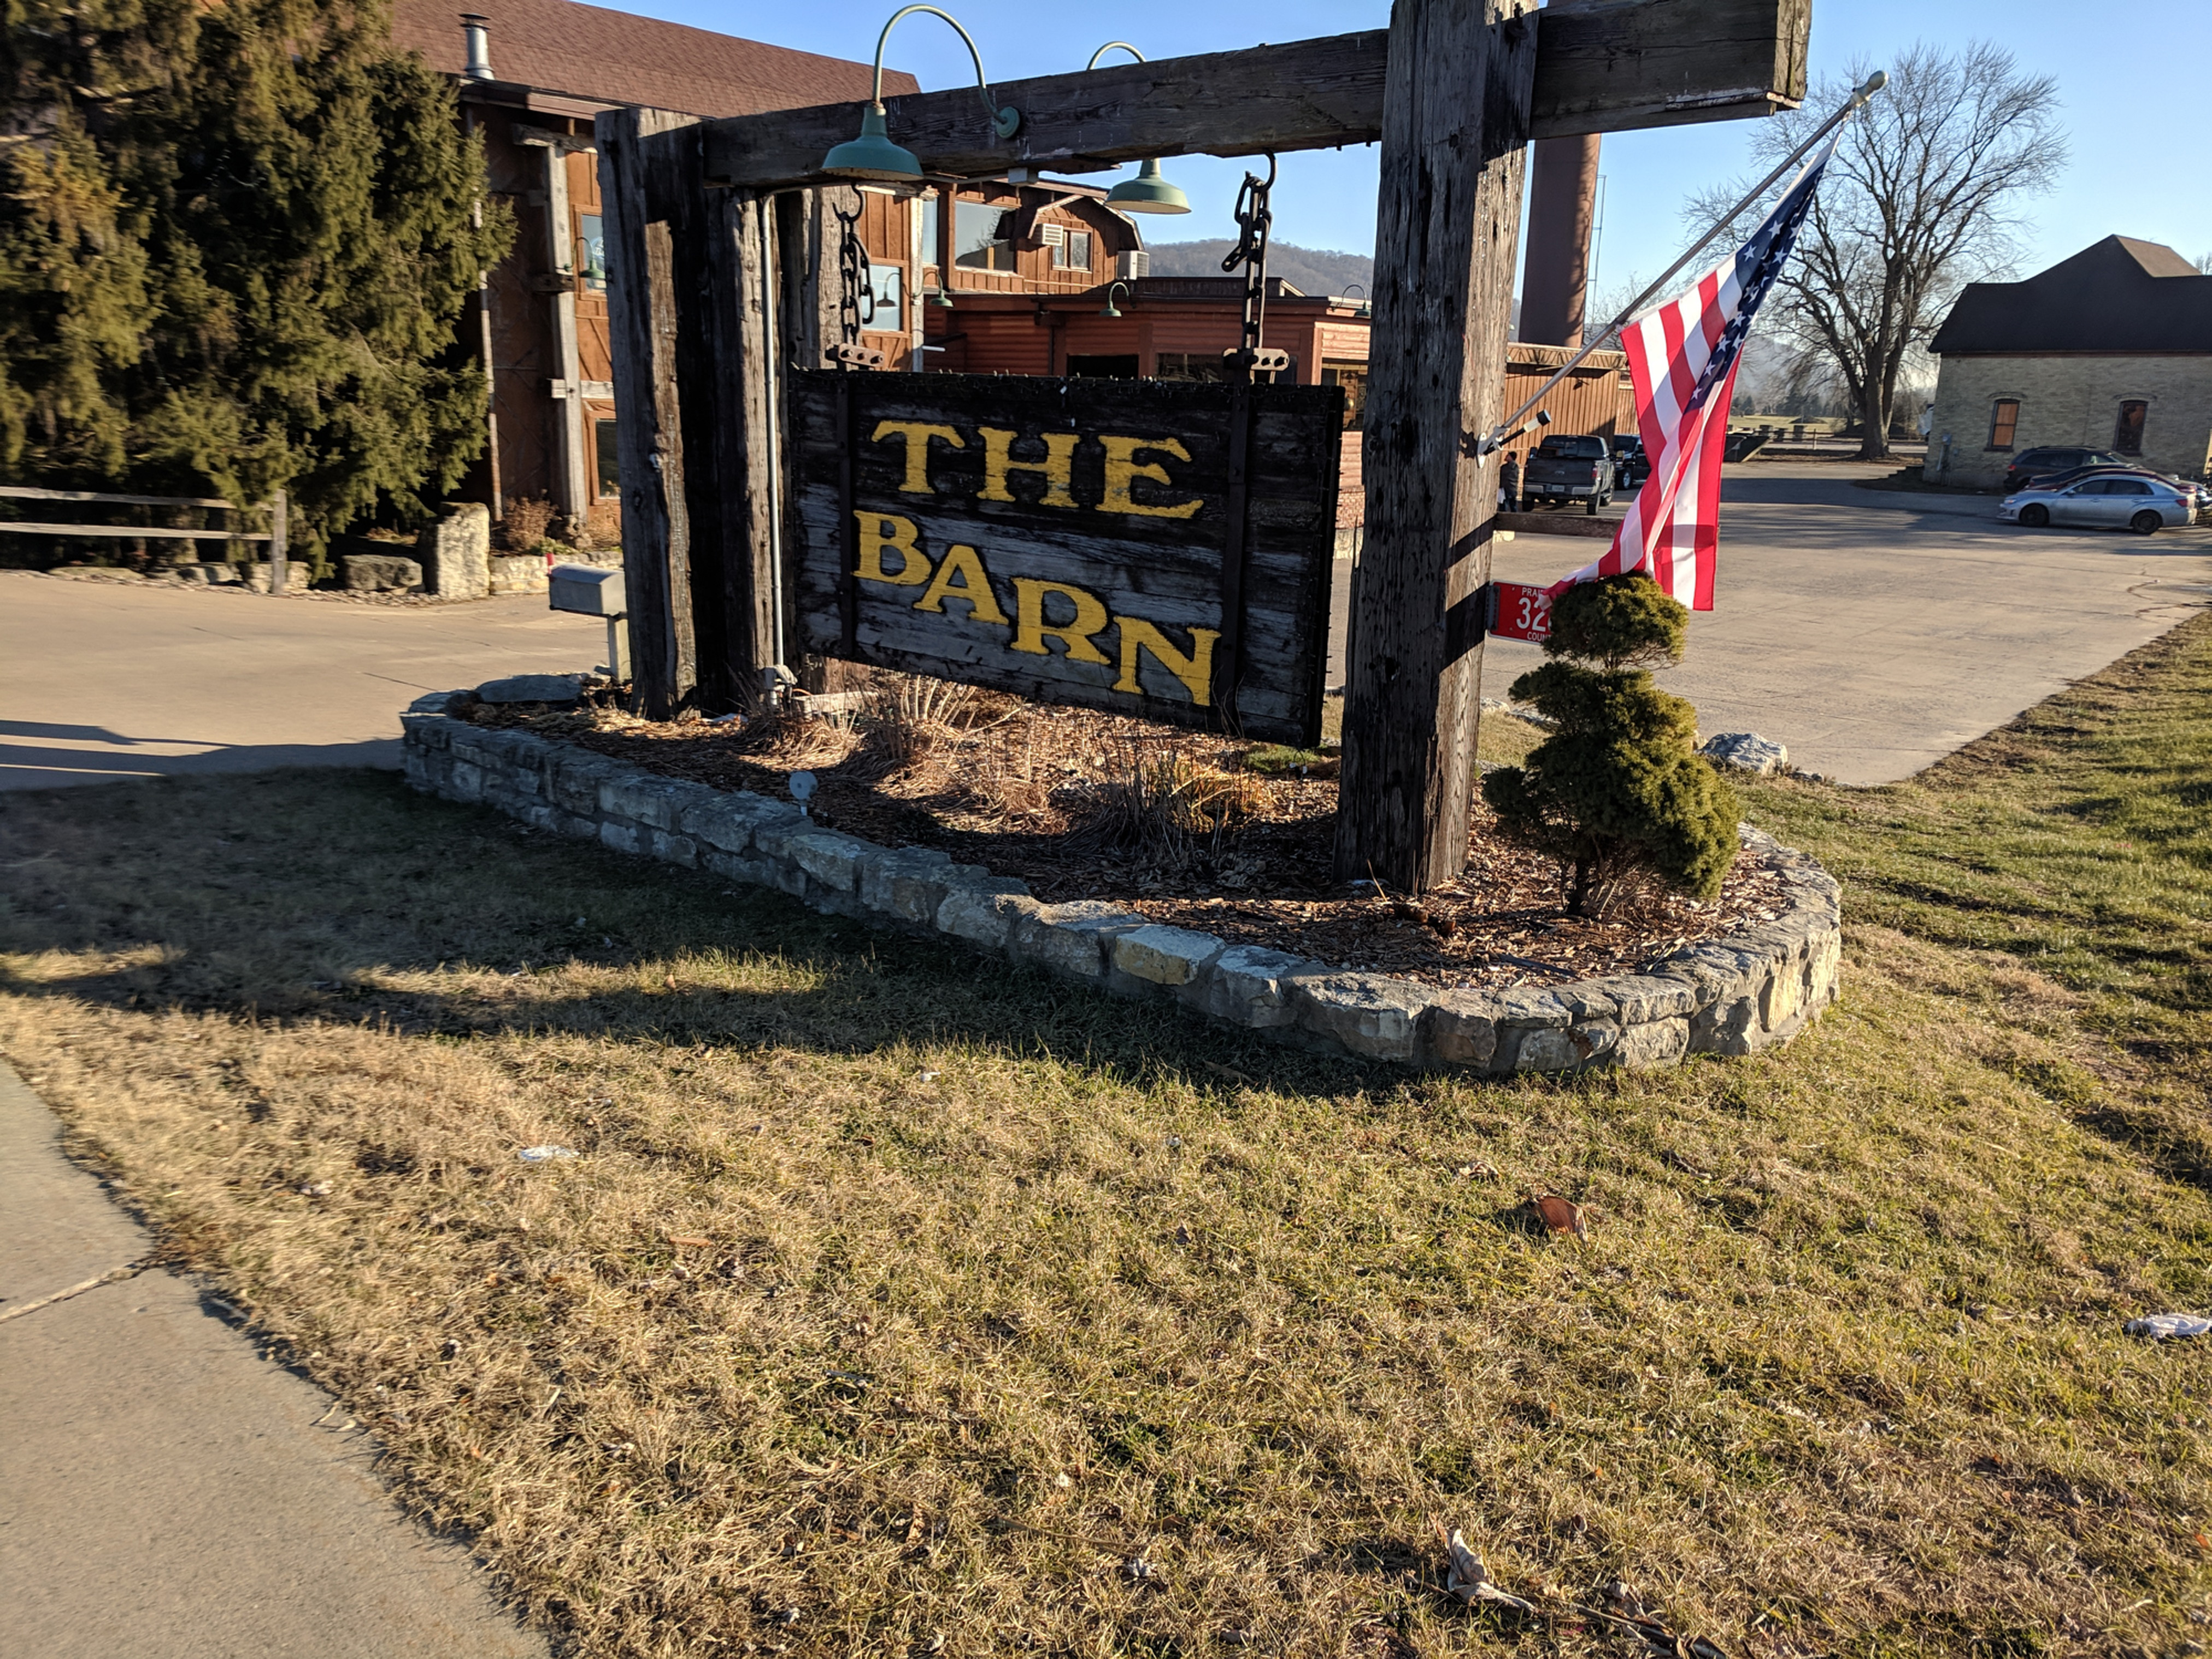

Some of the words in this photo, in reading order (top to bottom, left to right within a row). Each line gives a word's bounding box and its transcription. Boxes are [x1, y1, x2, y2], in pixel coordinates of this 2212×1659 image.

[873, 420, 1203, 519] THE
[853, 511, 1220, 706] BARN
[1516, 597, 1552, 632] 32
